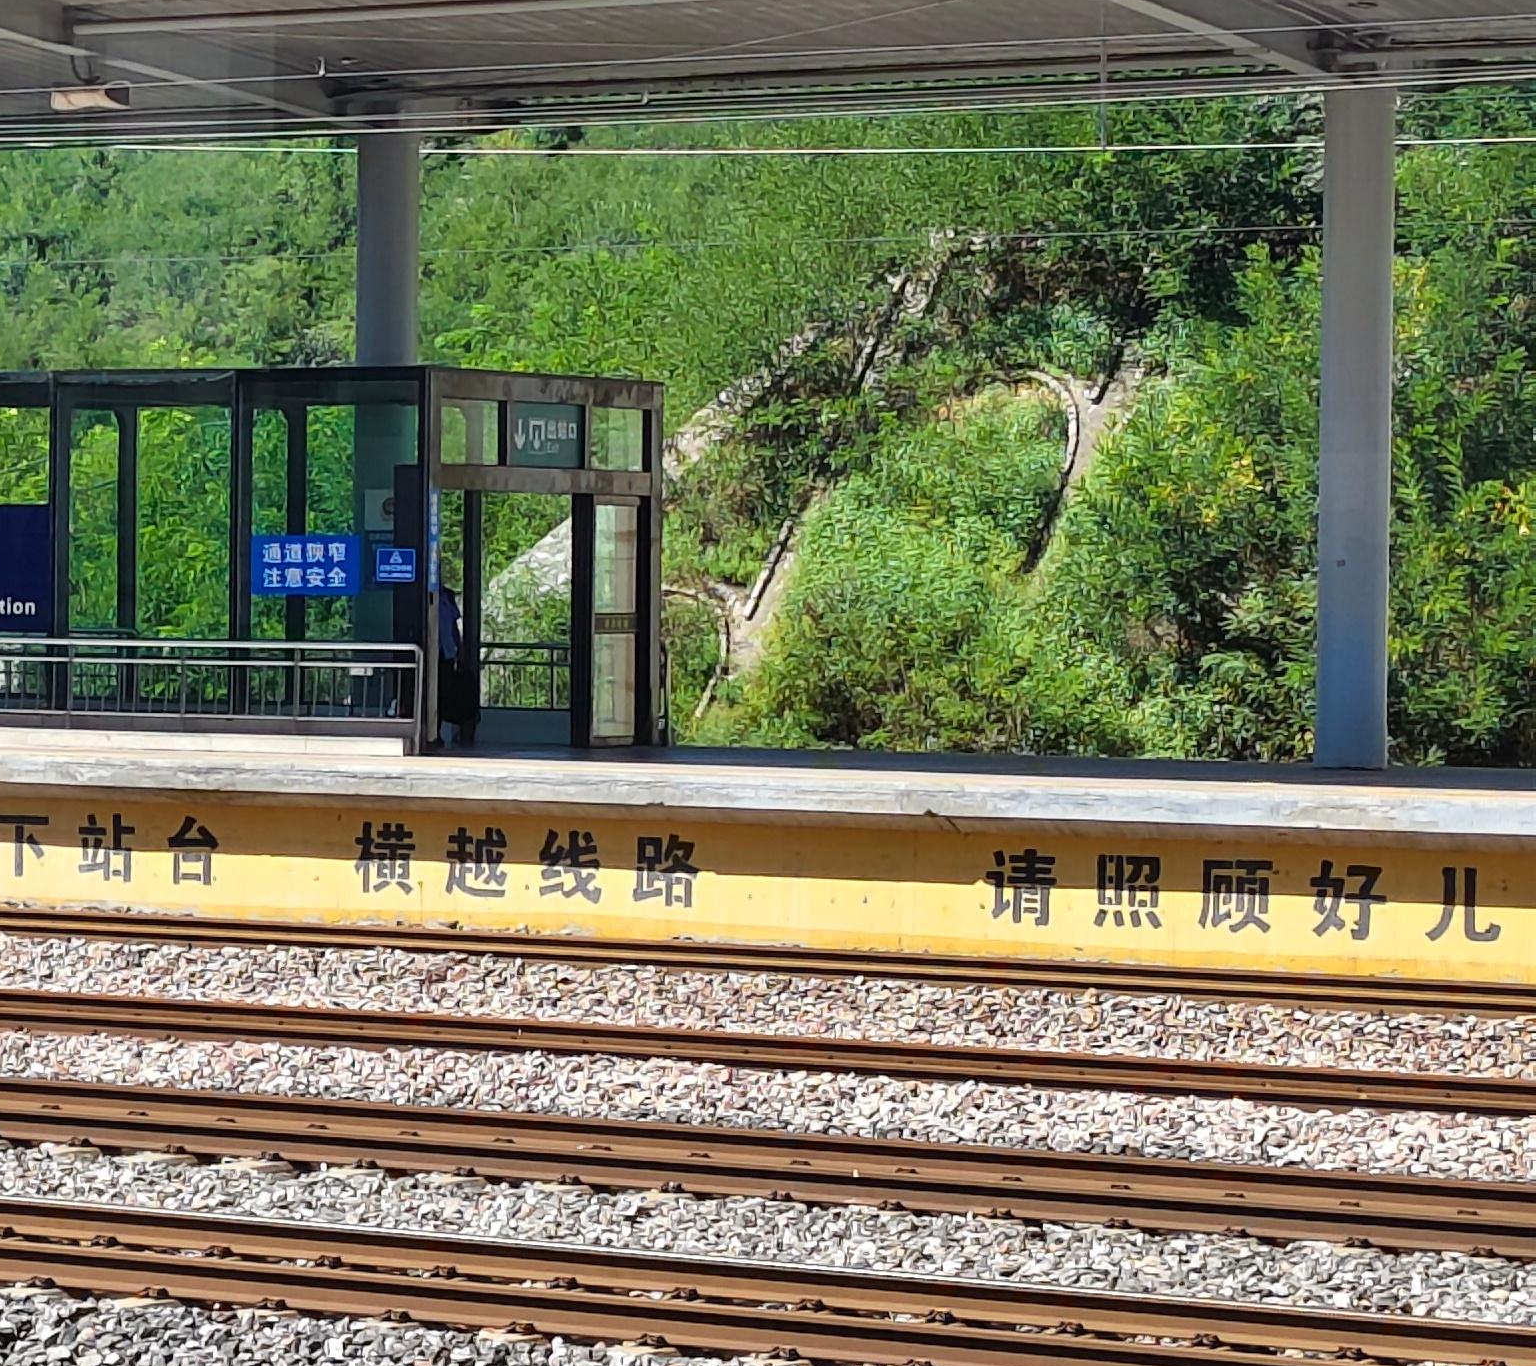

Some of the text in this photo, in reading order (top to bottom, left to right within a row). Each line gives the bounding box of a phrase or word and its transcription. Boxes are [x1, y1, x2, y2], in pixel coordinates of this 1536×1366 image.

[263, 566, 347, 588] 注意安全
[354, 820, 700, 908] 横越线路
[985, 848, 1501, 942] 请照顾好儿
